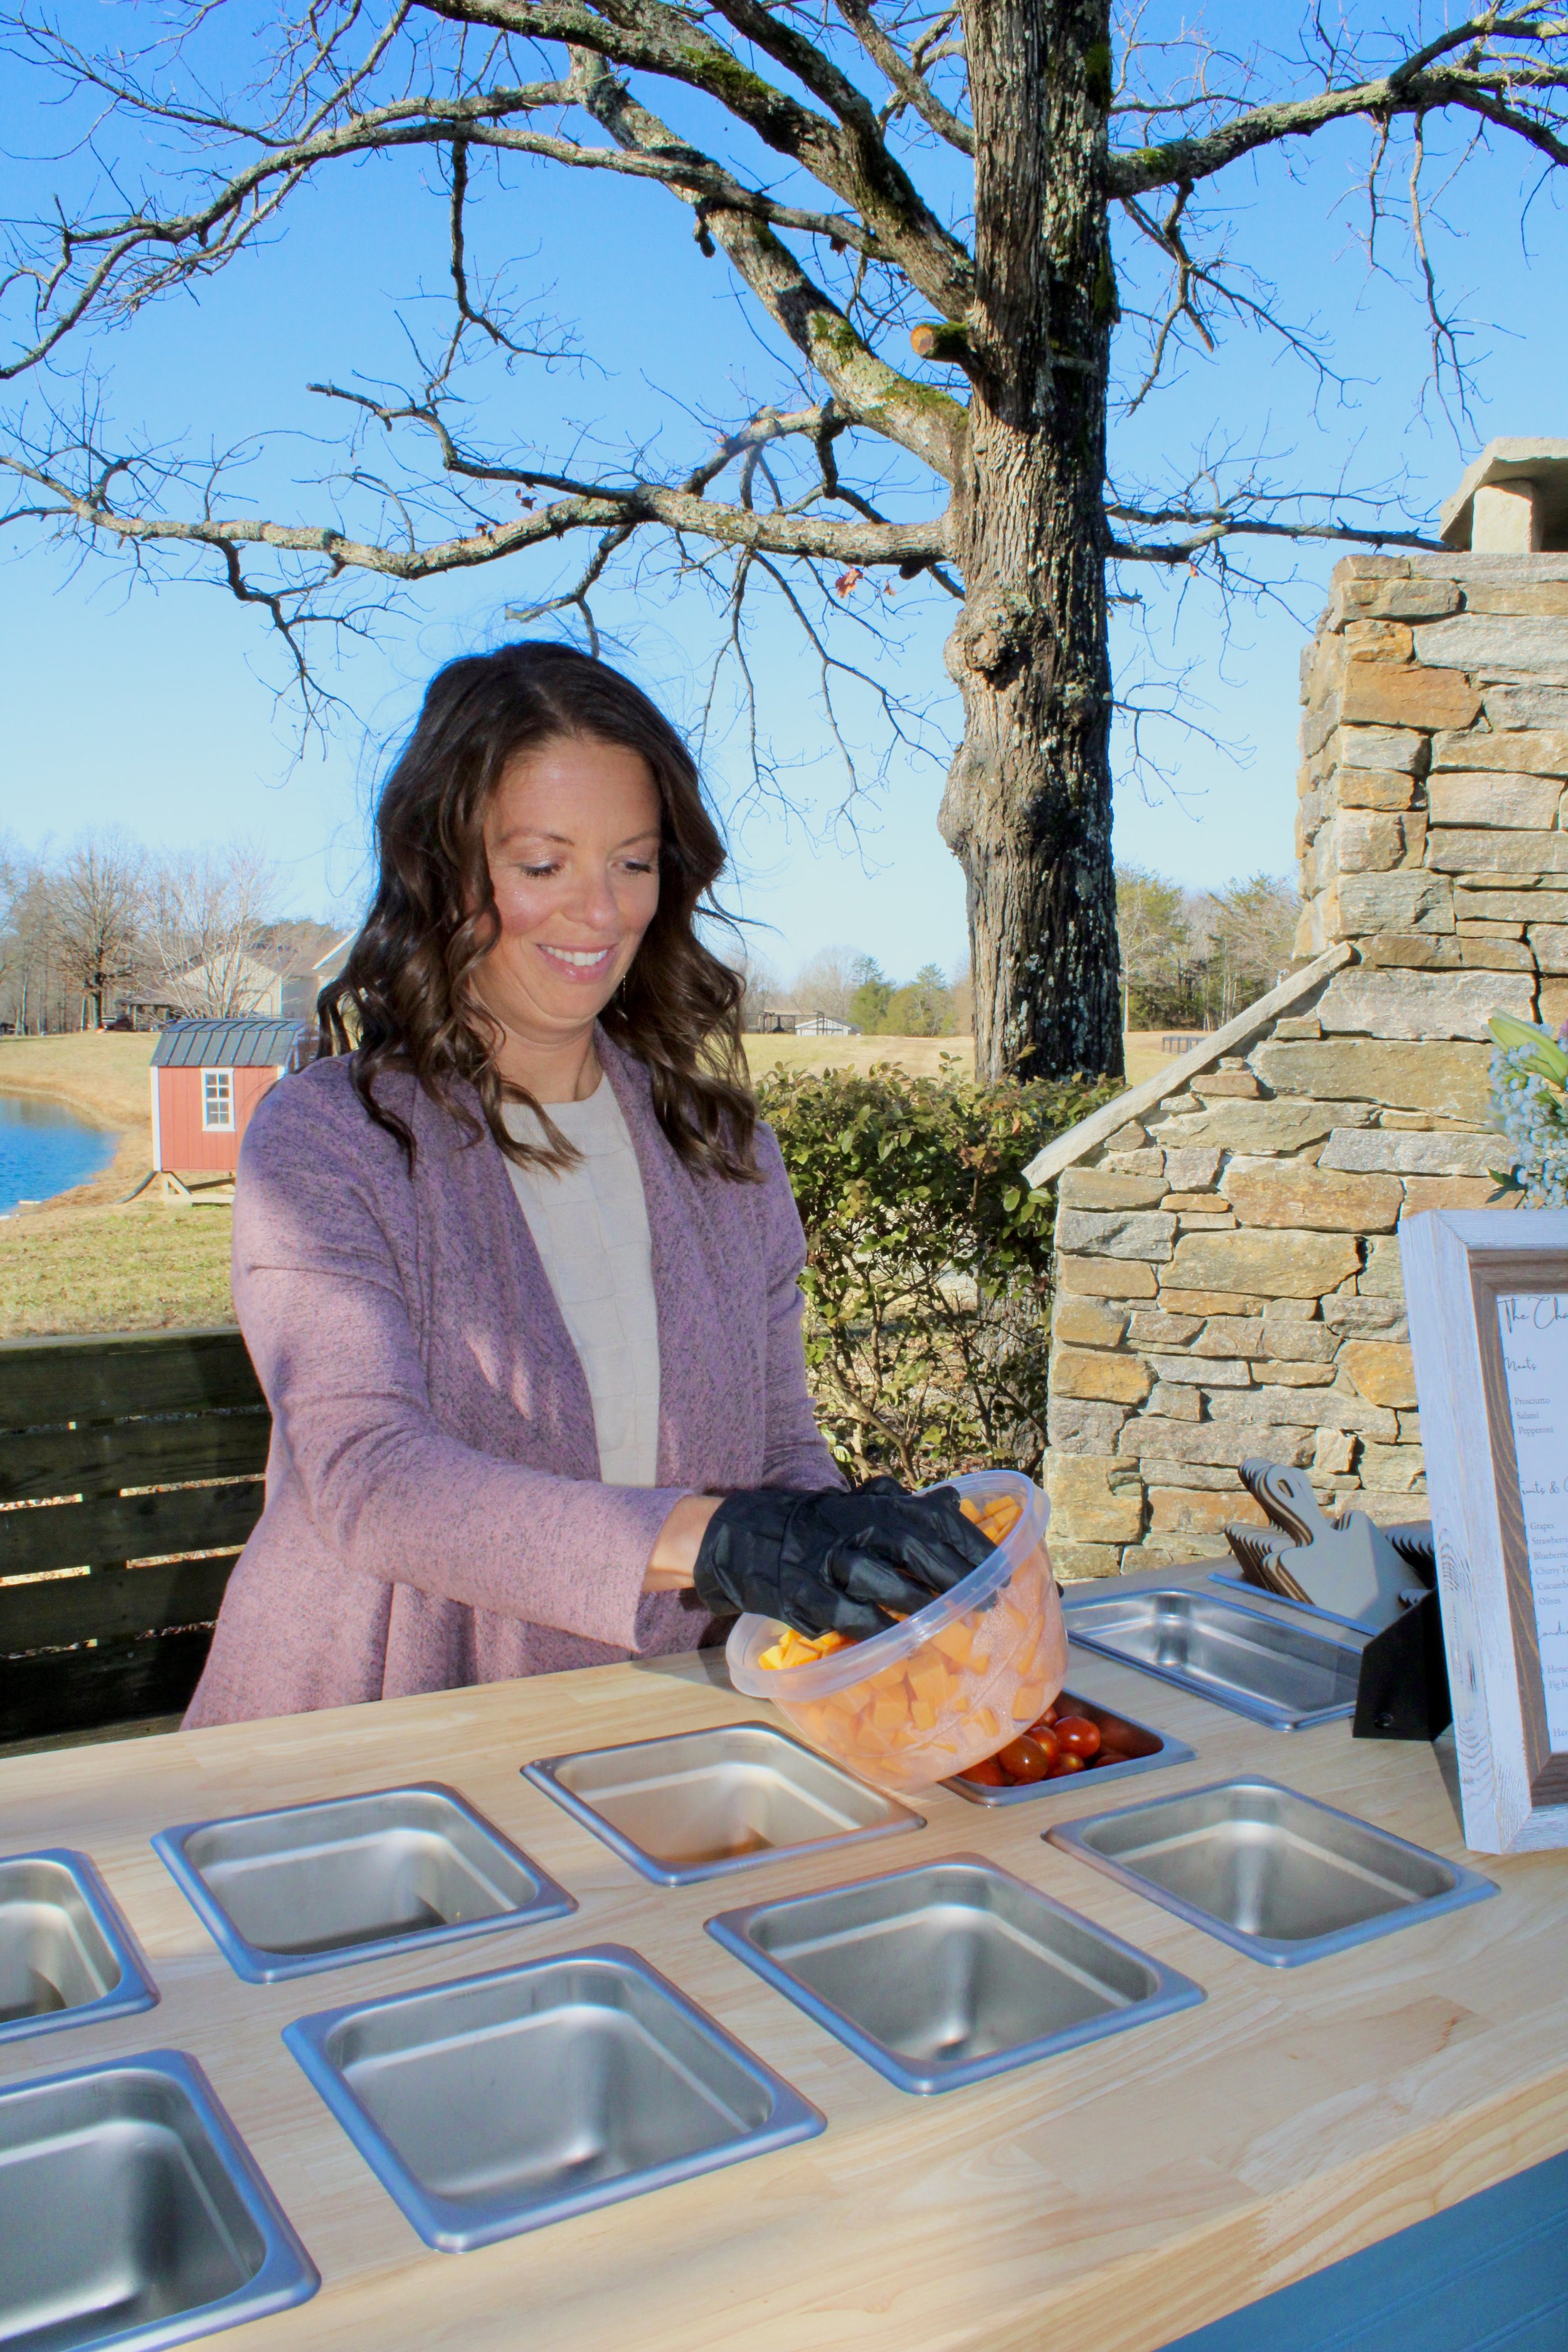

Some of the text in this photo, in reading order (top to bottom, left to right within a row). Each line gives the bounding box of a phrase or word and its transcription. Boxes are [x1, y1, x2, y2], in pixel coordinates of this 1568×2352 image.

[1497, 1298, 1529, 1333] The
[1505, 1357, 1536, 1371] Meats
[1515, 1397, 1550, 1405] Prosciutto
[1516, 1411, 1539, 1419] Salami
[1518, 1426, 1554, 1436] Pepperoni
[1550, 1481, 1559, 1494] &
[1530, 1522, 1555, 1532] Grapes
[1535, 1567, 1559, 1577] Cherry
[1539, 1597, 1560, 1605] Olives
[1549, 1681, 1560, 1691] Fig
